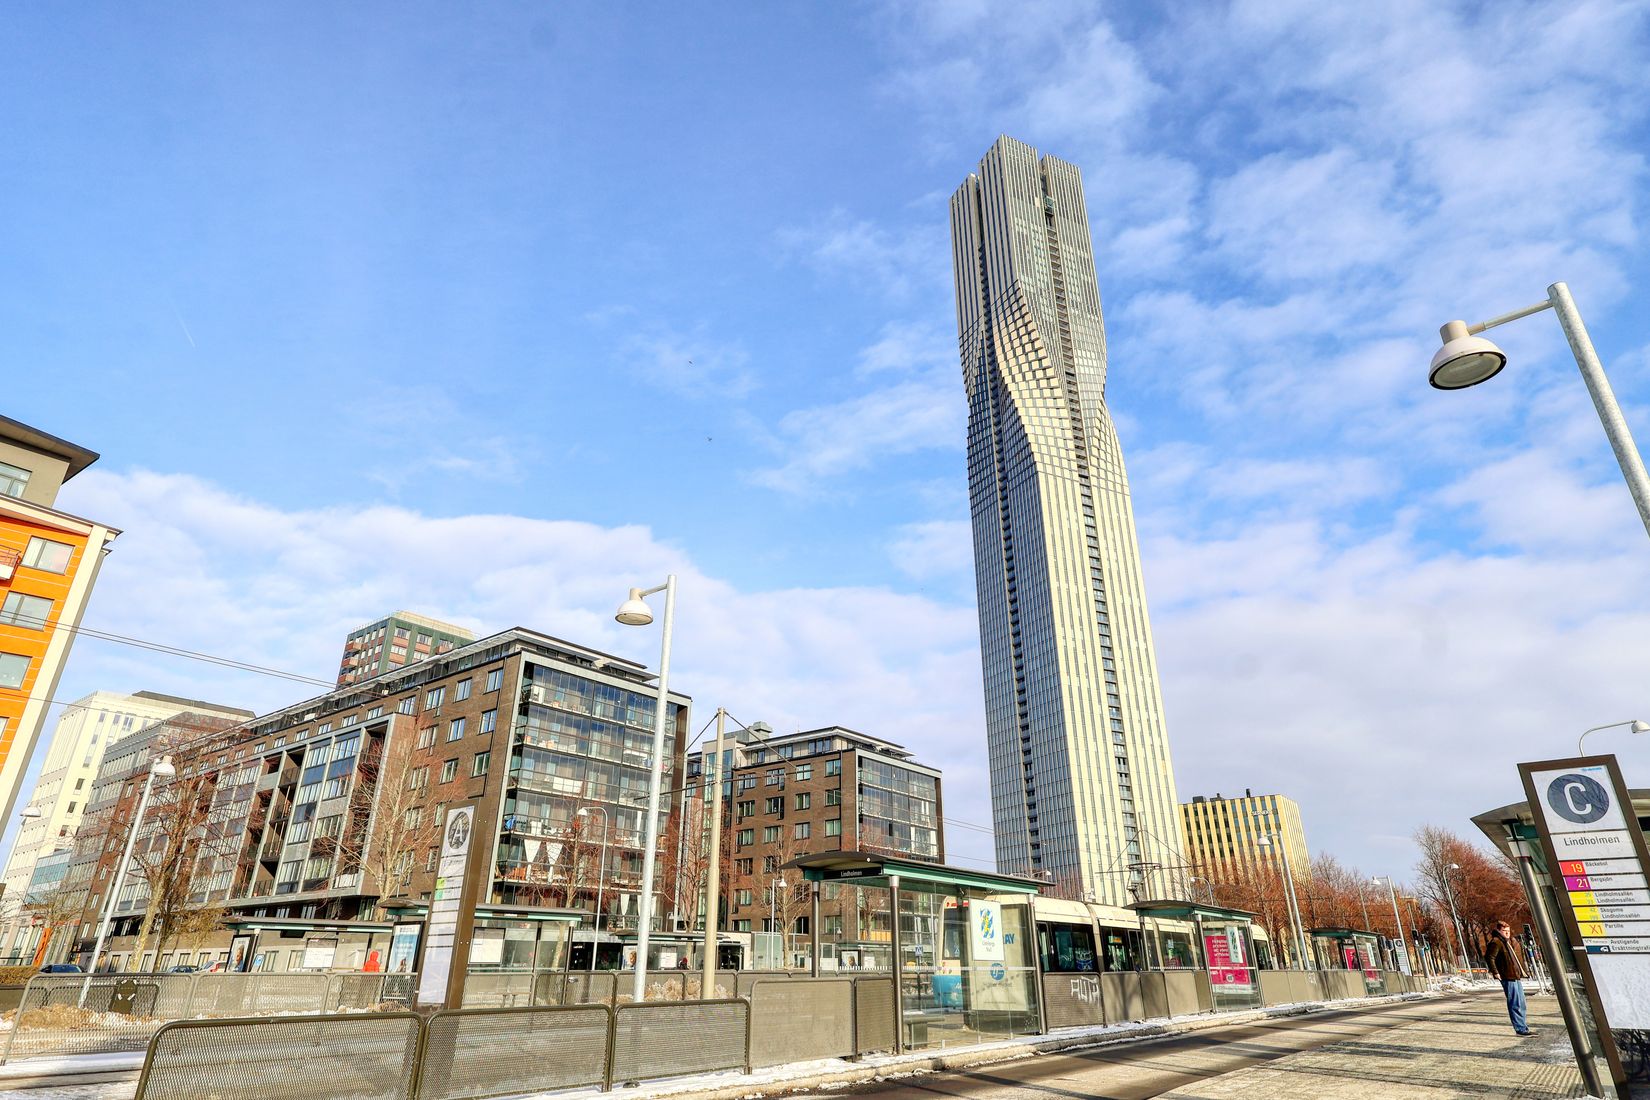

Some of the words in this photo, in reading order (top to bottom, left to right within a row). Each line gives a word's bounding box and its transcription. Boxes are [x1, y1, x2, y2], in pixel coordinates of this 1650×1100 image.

[1564, 782, 1592, 815] C
[452, 819, 463, 844] A
[1563, 836, 1620, 846] Lindholmen
[1571, 863, 1583, 873] 19
[1576, 878, 1589, 888] 21
[1589, 924, 1603, 934] X1
